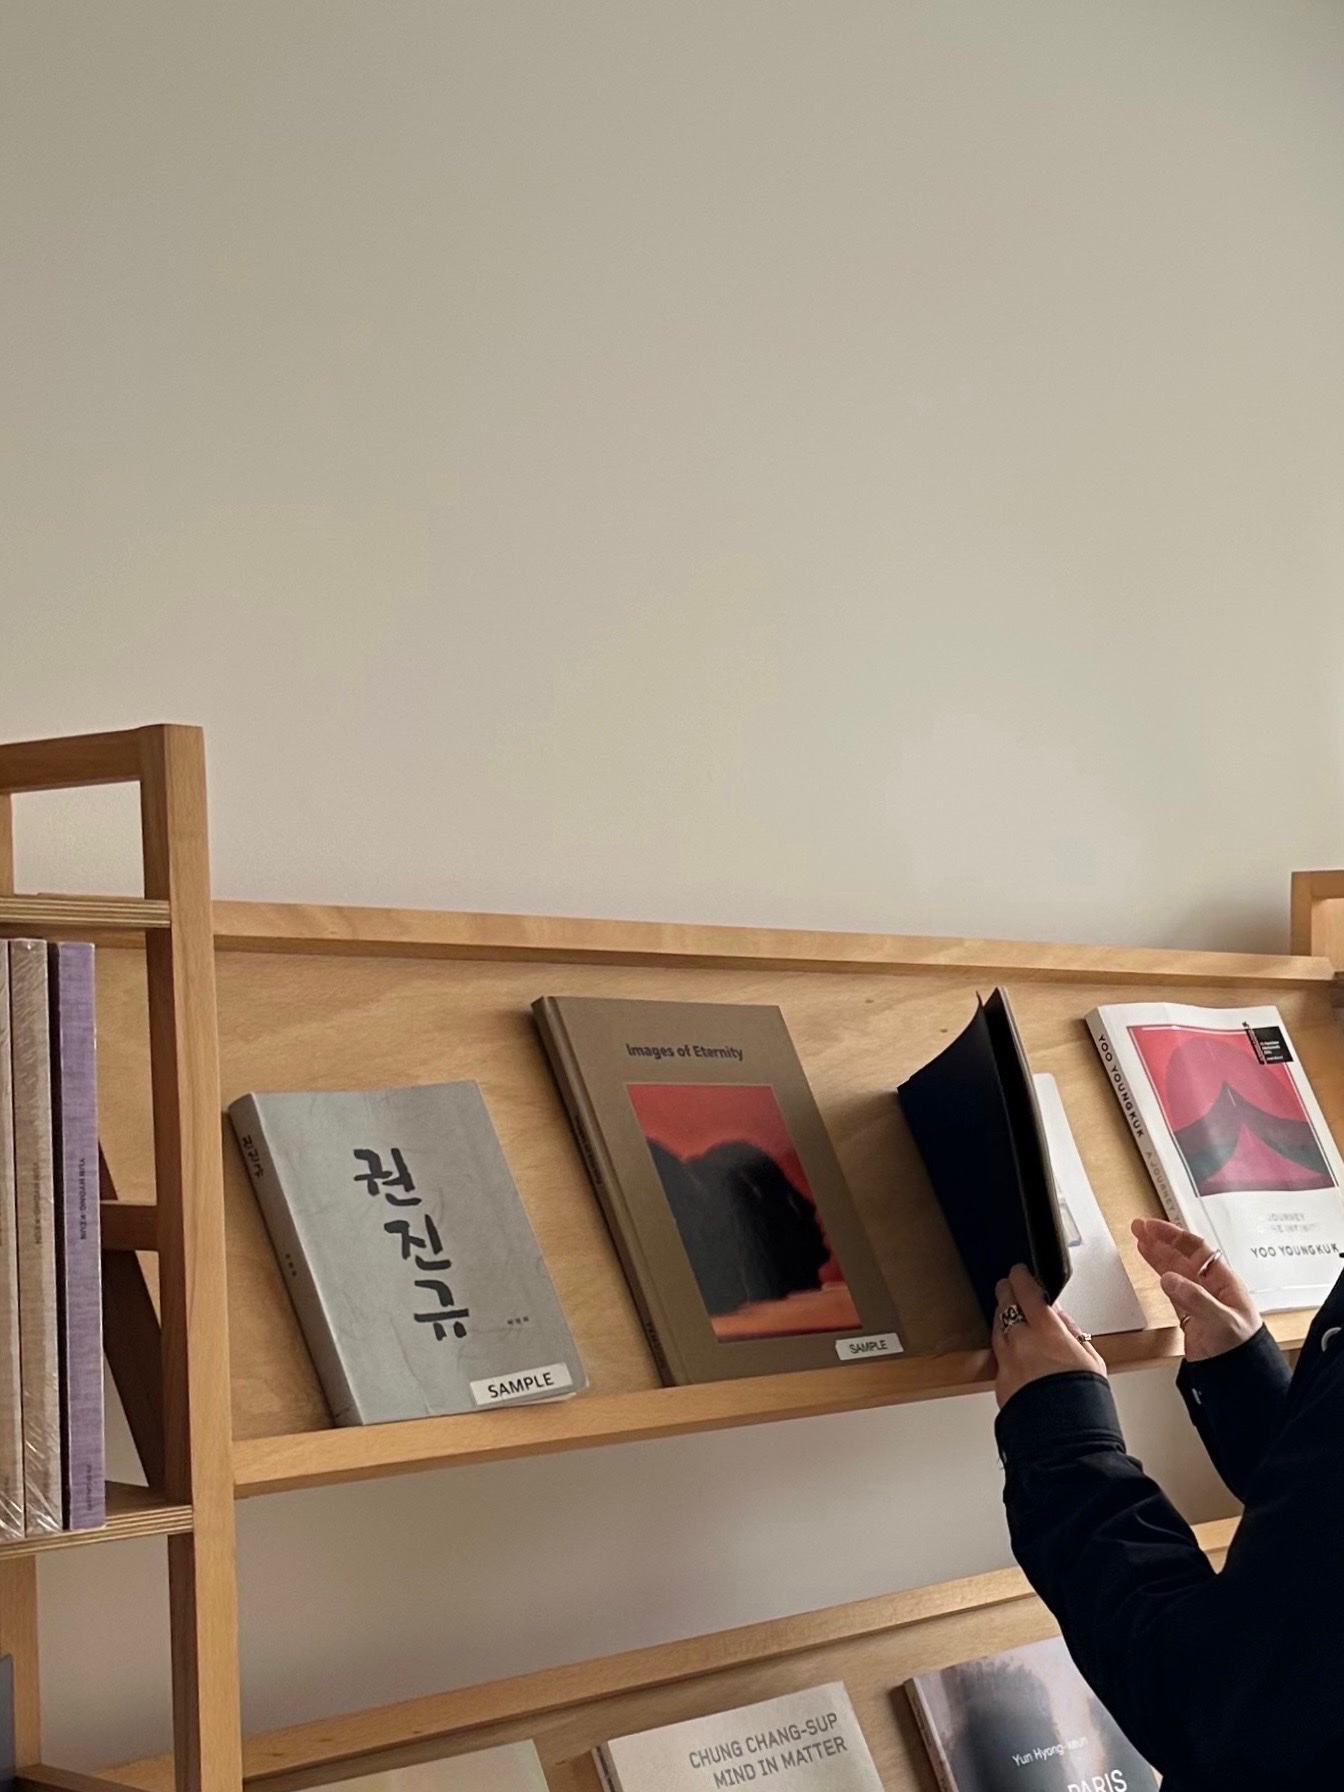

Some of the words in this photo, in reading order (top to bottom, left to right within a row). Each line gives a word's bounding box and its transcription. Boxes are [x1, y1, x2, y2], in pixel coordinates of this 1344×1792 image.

[625, 1043, 675, 1060] Images
[677, 1044, 691, 1057] of
[692, 1045, 743, 1061] Eternity
[1098, 1033, 1113, 1062] YOO
[1110, 1066, 1145, 1138] YOUNGKUK
[1150, 1159, 1176, 1212] JOURNEY
[353, 1148, 469, 1341] 권진규
[1250, 1246, 1277, 1259] YOO
[1278, 1243, 1339, 1257] YOUNGKUK
[849, 1340, 888, 1354] SAMPLE
[487, 1372, 554, 1399] SAMPLE
[689, 1741, 744, 1769] CHUNG
[745, 1712, 838, 1753] CHANG-SUP
[1012, 1754, 1034, 1767] Yun
[713, 1763, 757, 1789] MIND
[757, 1756, 779, 1776] IN
[780, 1736, 848, 1769] MATTER
